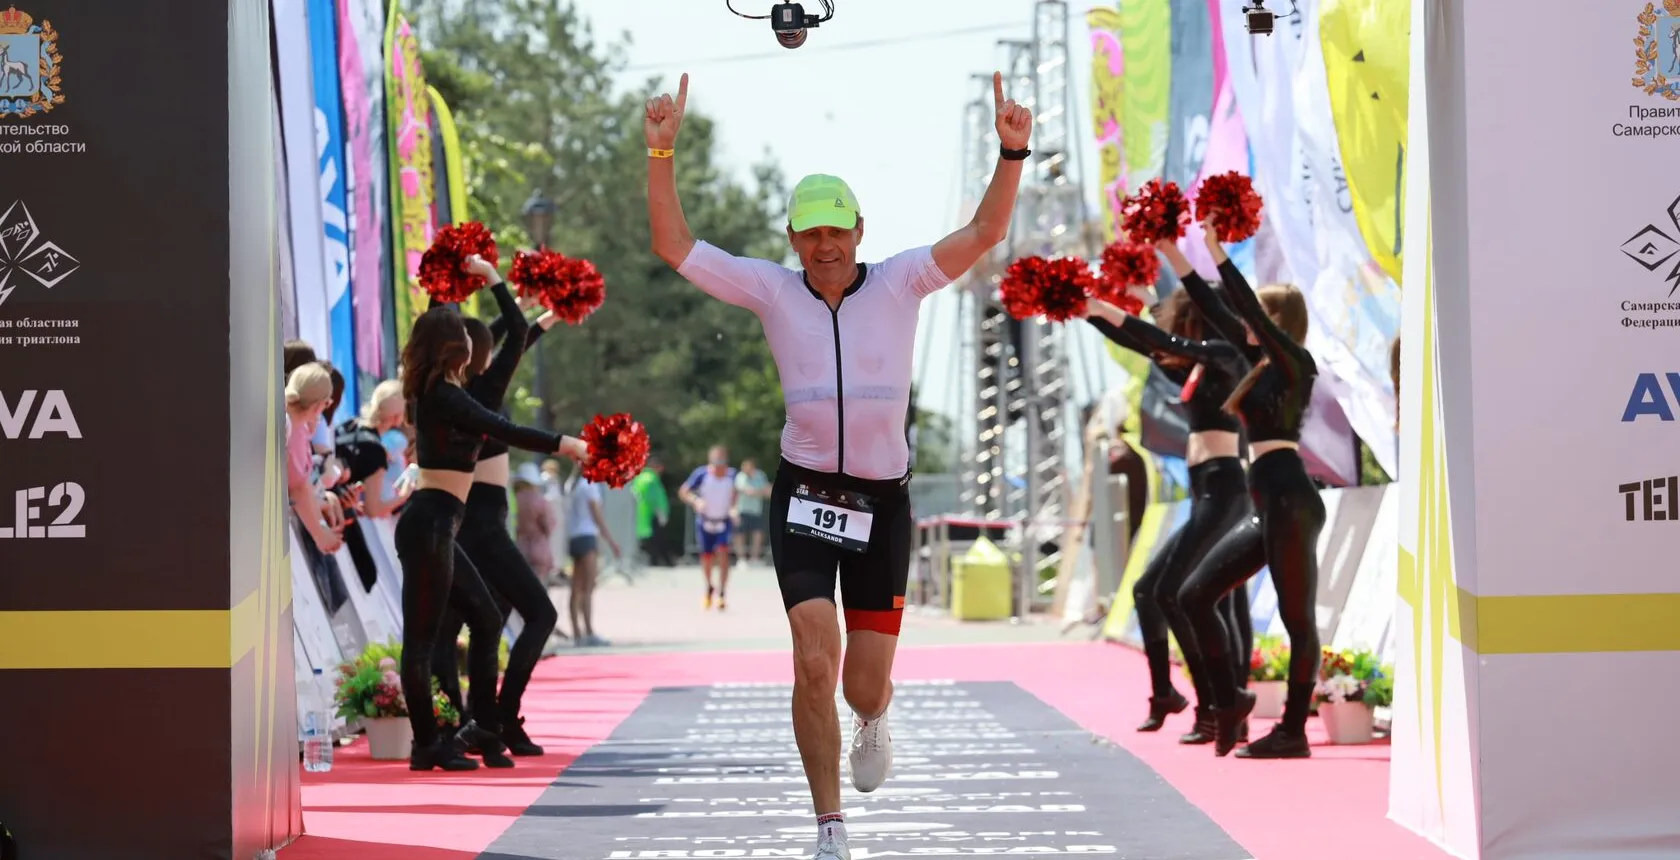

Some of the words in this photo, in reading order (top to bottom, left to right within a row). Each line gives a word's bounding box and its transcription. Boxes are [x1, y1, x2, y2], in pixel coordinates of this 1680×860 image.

[0, 125, 69, 135] тельство
[25, 140, 86, 153] области
[16, 317, 79, 328] областная
[16, 336, 81, 347] триатлона
[812, 507, 849, 533] 191
[810, 529, 843, 543] ALEKSANDR
[609, 848, 804, 857] IRON
[909, 845, 1117, 854] STAR
